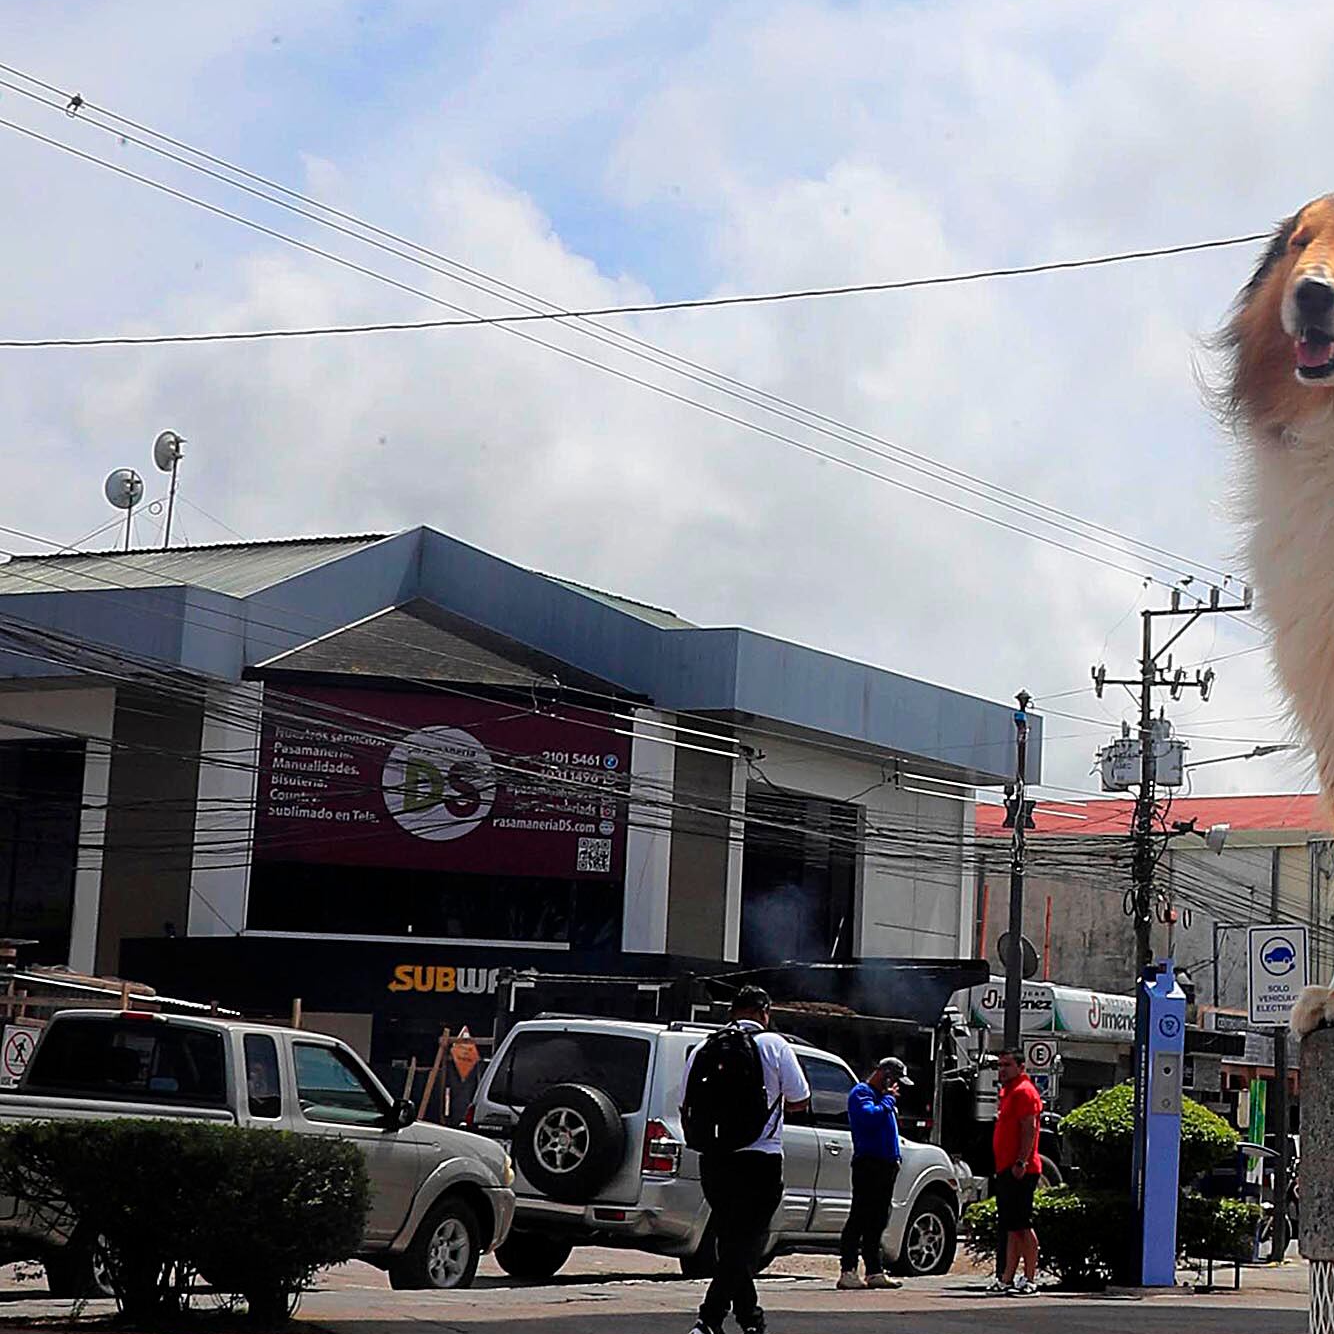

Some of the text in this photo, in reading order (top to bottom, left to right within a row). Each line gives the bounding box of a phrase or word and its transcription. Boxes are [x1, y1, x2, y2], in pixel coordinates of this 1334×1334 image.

[272, 757, 360, 775] Manualidades.
[542, 751, 600, 766] 2101 5461
[268, 805, 333, 819] Sublimado
[335, 811, 350, 821] en
[387, 965, 500, 994] SUBWA
[1268, 985, 1290, 993] SOLO
[982, 989, 1053, 1010] Jienez
[1088, 995, 1137, 1032] Jimene
[1036, 1048, 1044, 1061] E
